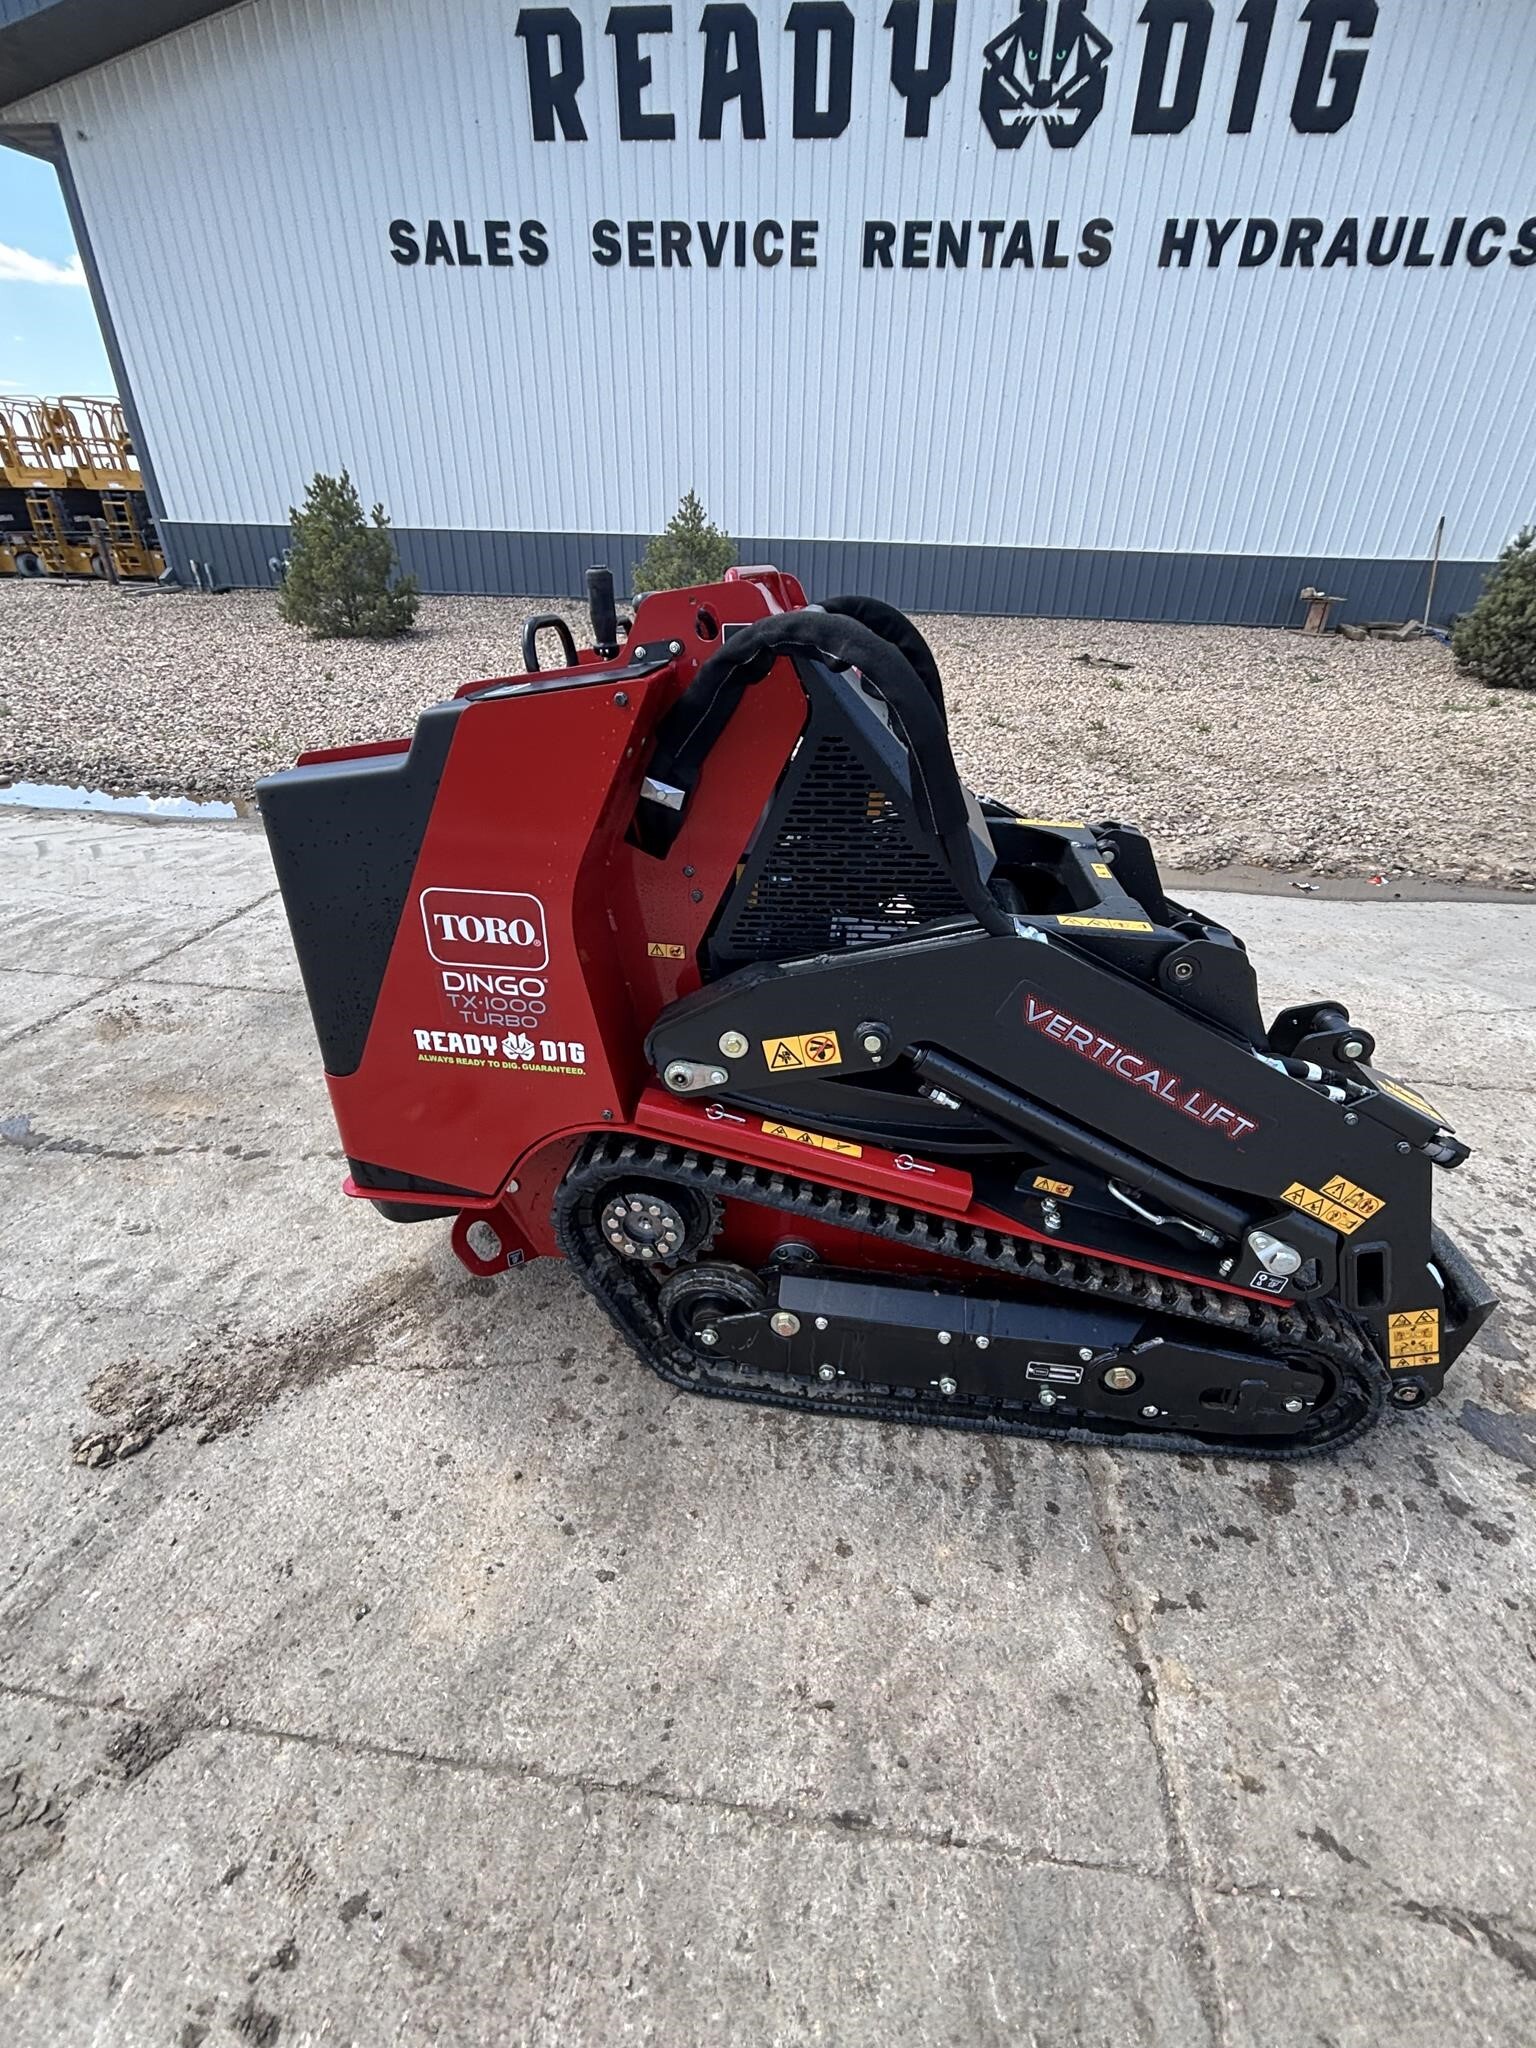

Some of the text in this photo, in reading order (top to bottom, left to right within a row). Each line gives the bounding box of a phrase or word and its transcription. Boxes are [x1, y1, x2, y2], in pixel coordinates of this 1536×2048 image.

[515, 0, 1379, 141] READY DIG
[389, 216, 1536, 268] SALES SERVICE RENTALS HYDRAULICS
[442, 971, 546, 998] DINGO
[459, 1010, 538, 1028] TURBO
[413, 1029, 586, 1064] READY DIG
[418, 1053, 586, 1076] ALWAYS READY TO DIG. GUARANTEED.
[1027, 999, 1255, 1136] VERTICAL LIFT
